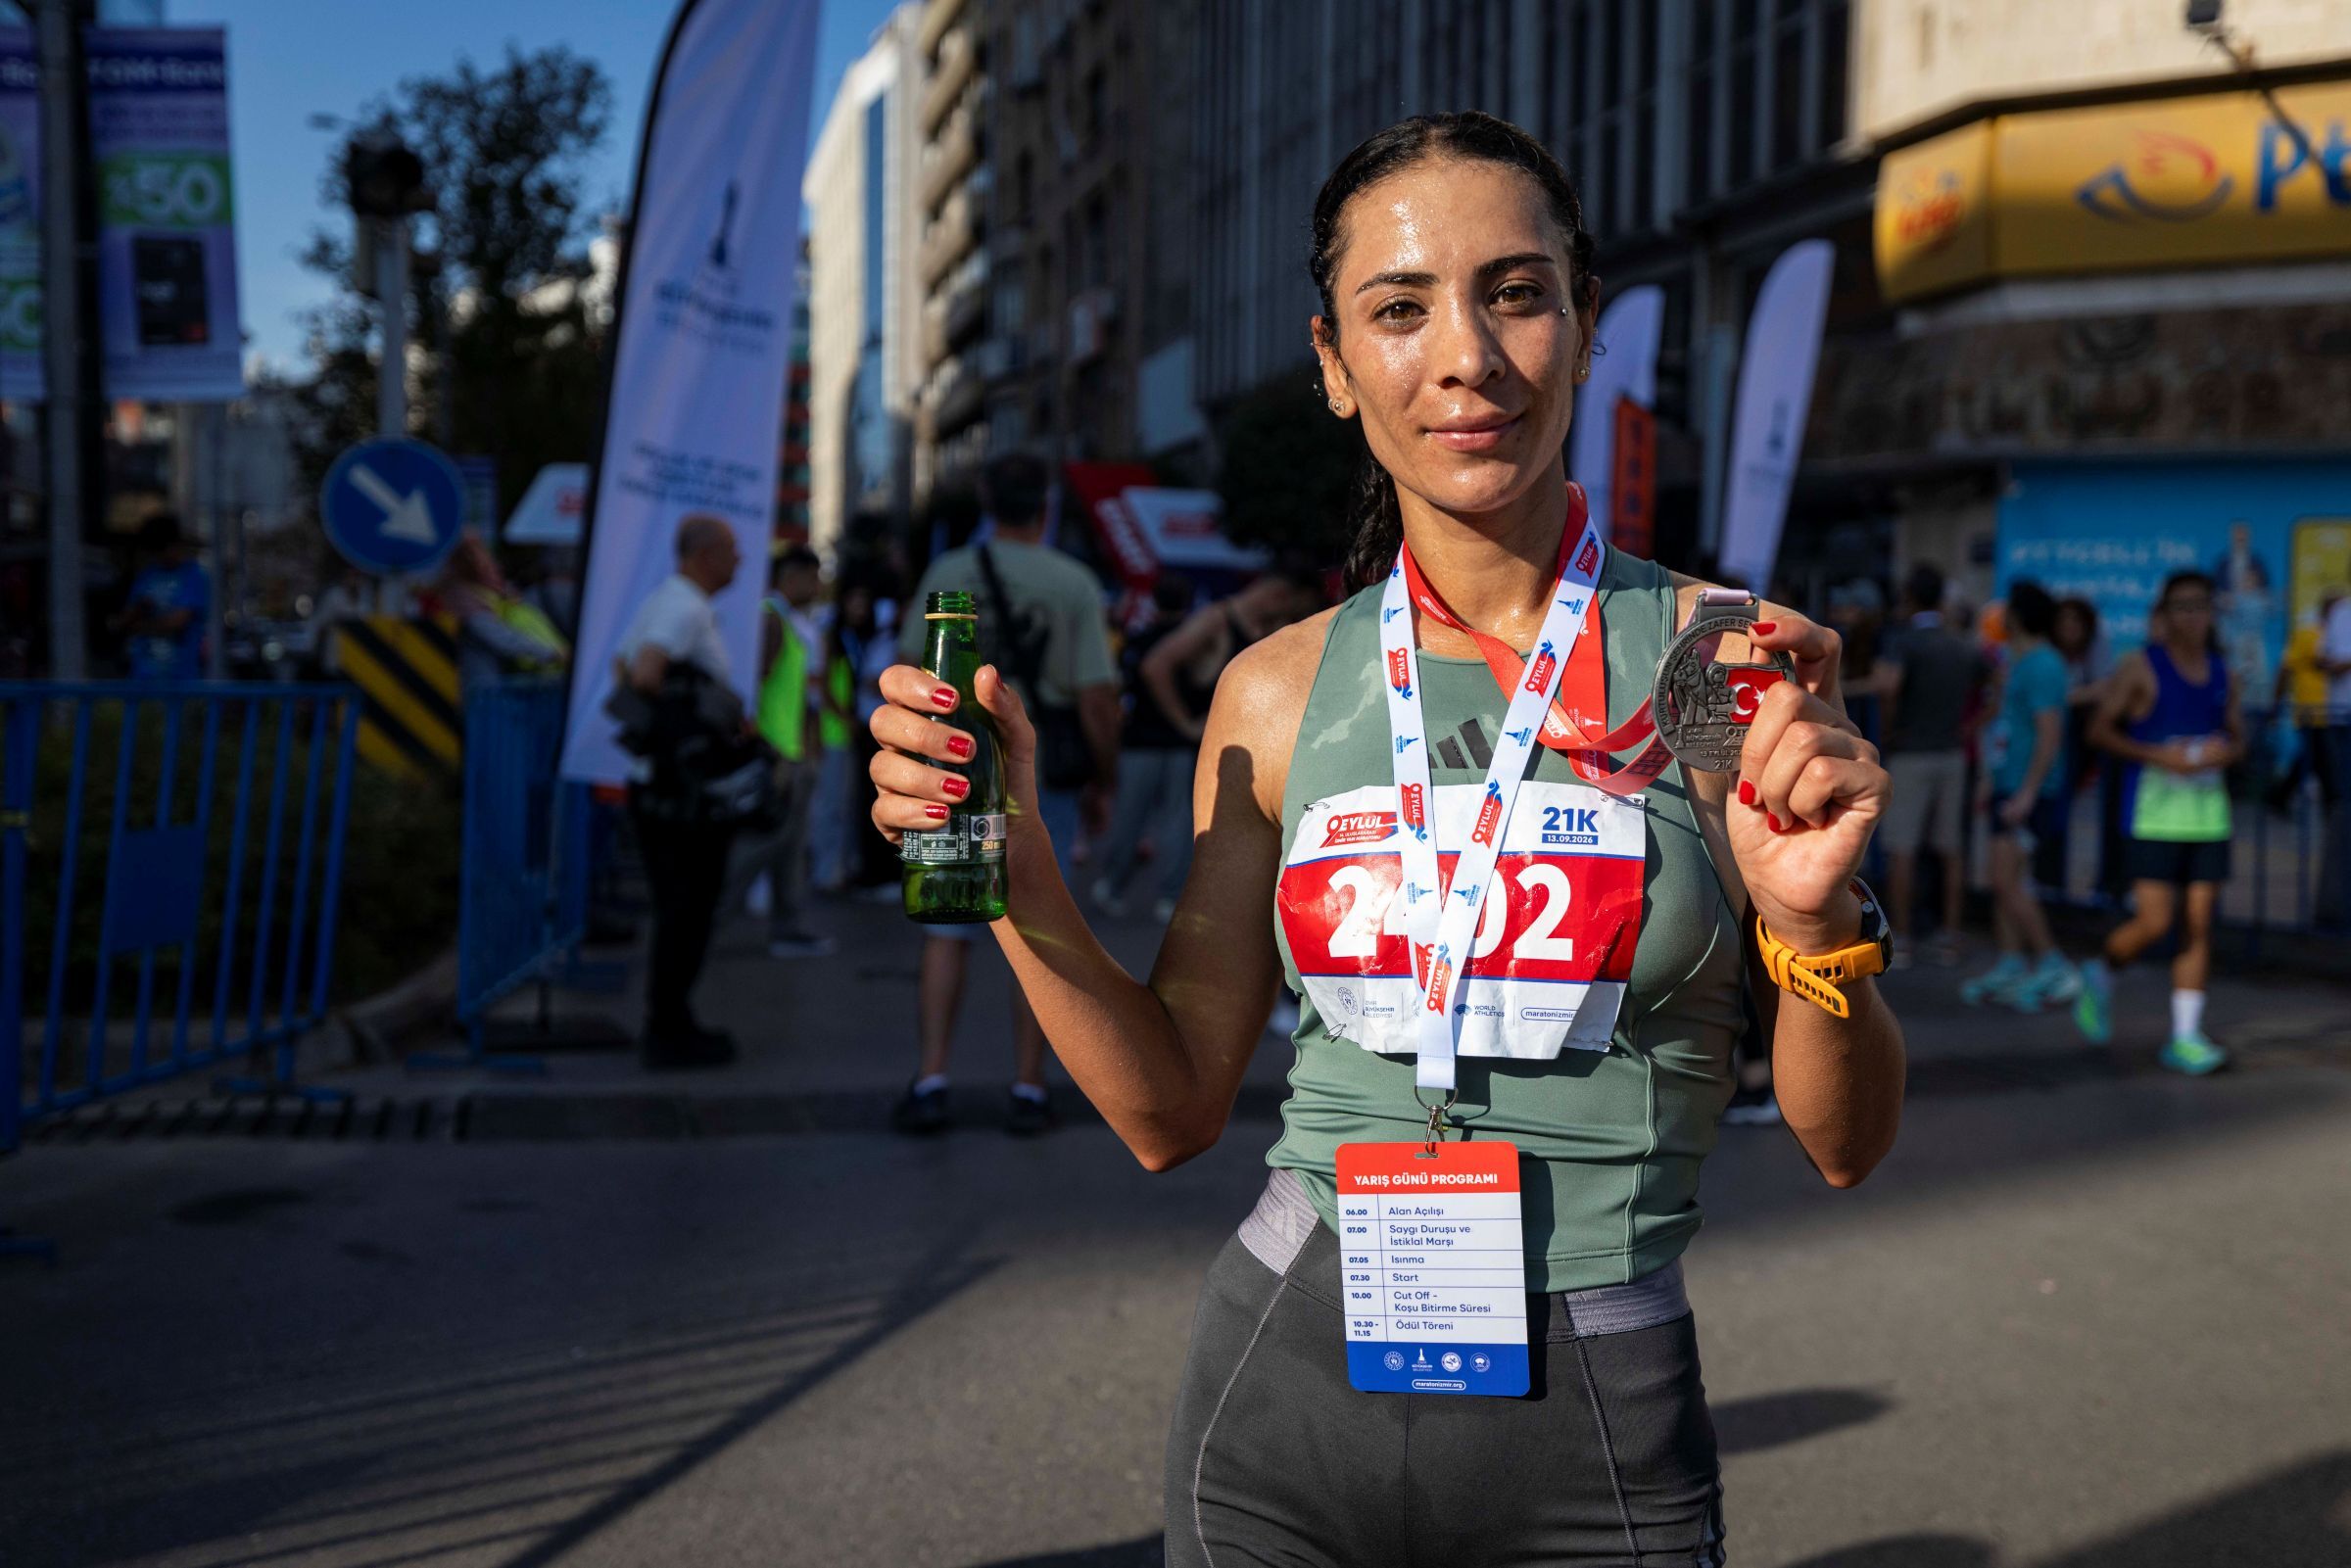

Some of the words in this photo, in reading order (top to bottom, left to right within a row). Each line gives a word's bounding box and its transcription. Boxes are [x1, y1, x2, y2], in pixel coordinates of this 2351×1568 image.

[1708, 618, 1736, 631] ZAFER
[1714, 759, 1733, 770] 21K
[1542, 806, 1599, 832] 21K
[1547, 834, 1594, 843] 13.09.2026
[982, 840, 993, 850] 250
[1354, 1174, 1390, 1187] YARIŞ
[1392, 1172, 1428, 1185] GÜNÜ
[1431, 1173, 1498, 1185] PROGRAMI
[1388, 1207, 1412, 1215] Alan
[1414, 1207, 1444, 1217] Açılışı
[1389, 1225, 1418, 1235] Saygı
[1420, 1225, 1457, 1235] Duruşu
[1390, 1235, 1423, 1246] İstiklal
[1425, 1237, 1454, 1248] Marşı
[1392, 1273, 1418, 1282] Start
[1393, 1291, 1412, 1300] Cut
[1415, 1291, 1430, 1300] Off
[1394, 1303, 1418, 1312] Koşu
[1420, 1304, 1457, 1312] Bitirme
[1460, 1304, 1491, 1312] Süresi
[1396, 1320, 1420, 1330] Ödül
[1421, 1321, 1454, 1330] Töreni
